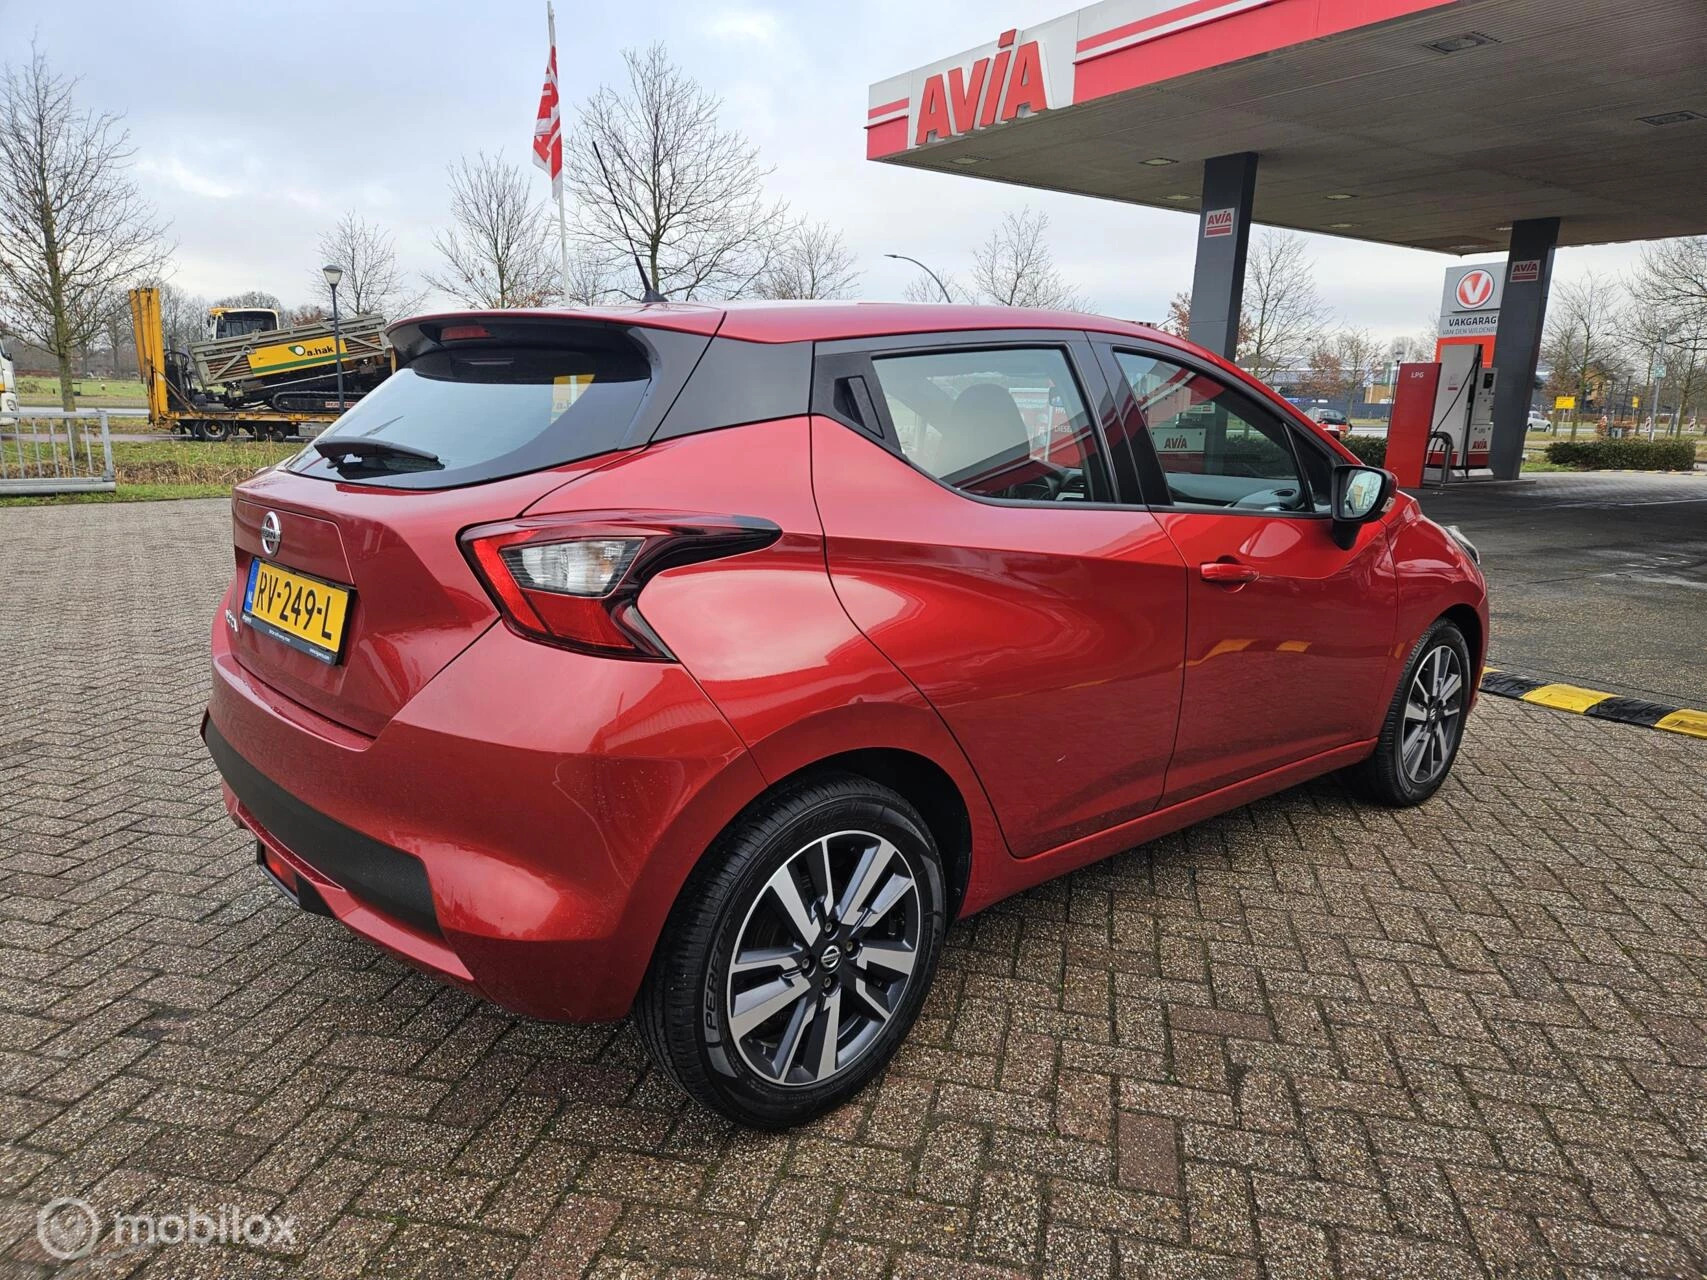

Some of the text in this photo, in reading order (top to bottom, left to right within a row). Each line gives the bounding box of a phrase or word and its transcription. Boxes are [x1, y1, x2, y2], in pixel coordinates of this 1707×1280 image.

[1449, 316, 1497, 327] VAKGARAG
[306, 345, 334, 357] a.hak
[1410, 371, 1425, 379] LPG
[256, 571, 332, 641] RV-249-L
